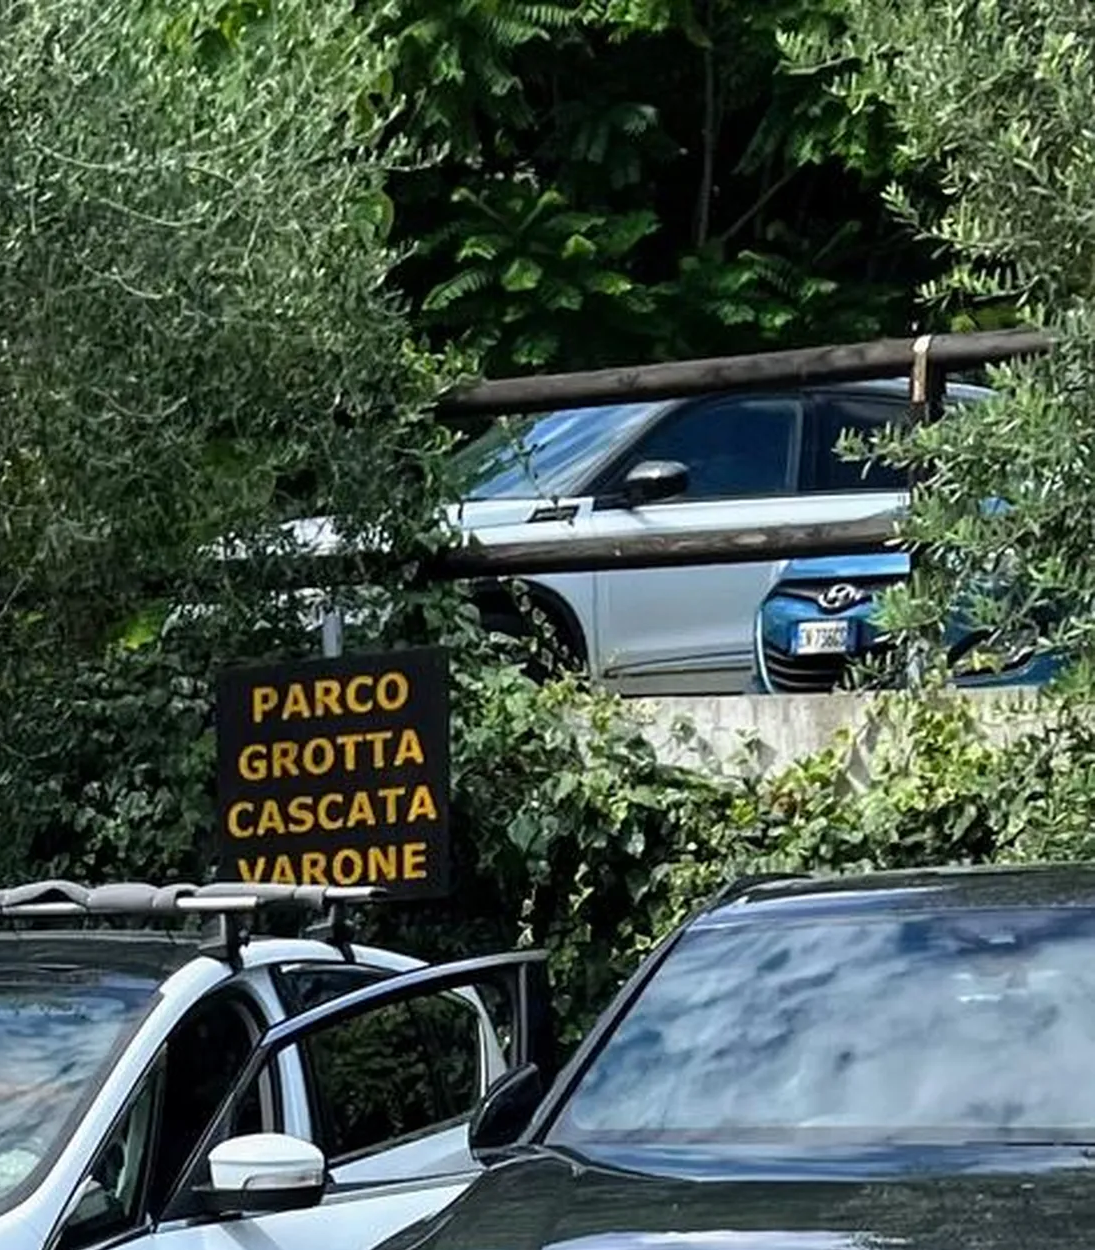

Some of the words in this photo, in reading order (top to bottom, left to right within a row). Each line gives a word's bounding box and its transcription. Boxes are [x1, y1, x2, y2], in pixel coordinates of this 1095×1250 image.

[251, 671, 409, 724] PARCO
[237, 728, 424, 781] GROTTA
[226, 784, 438, 838] CASCATA
[237, 841, 427, 886] VARONE
